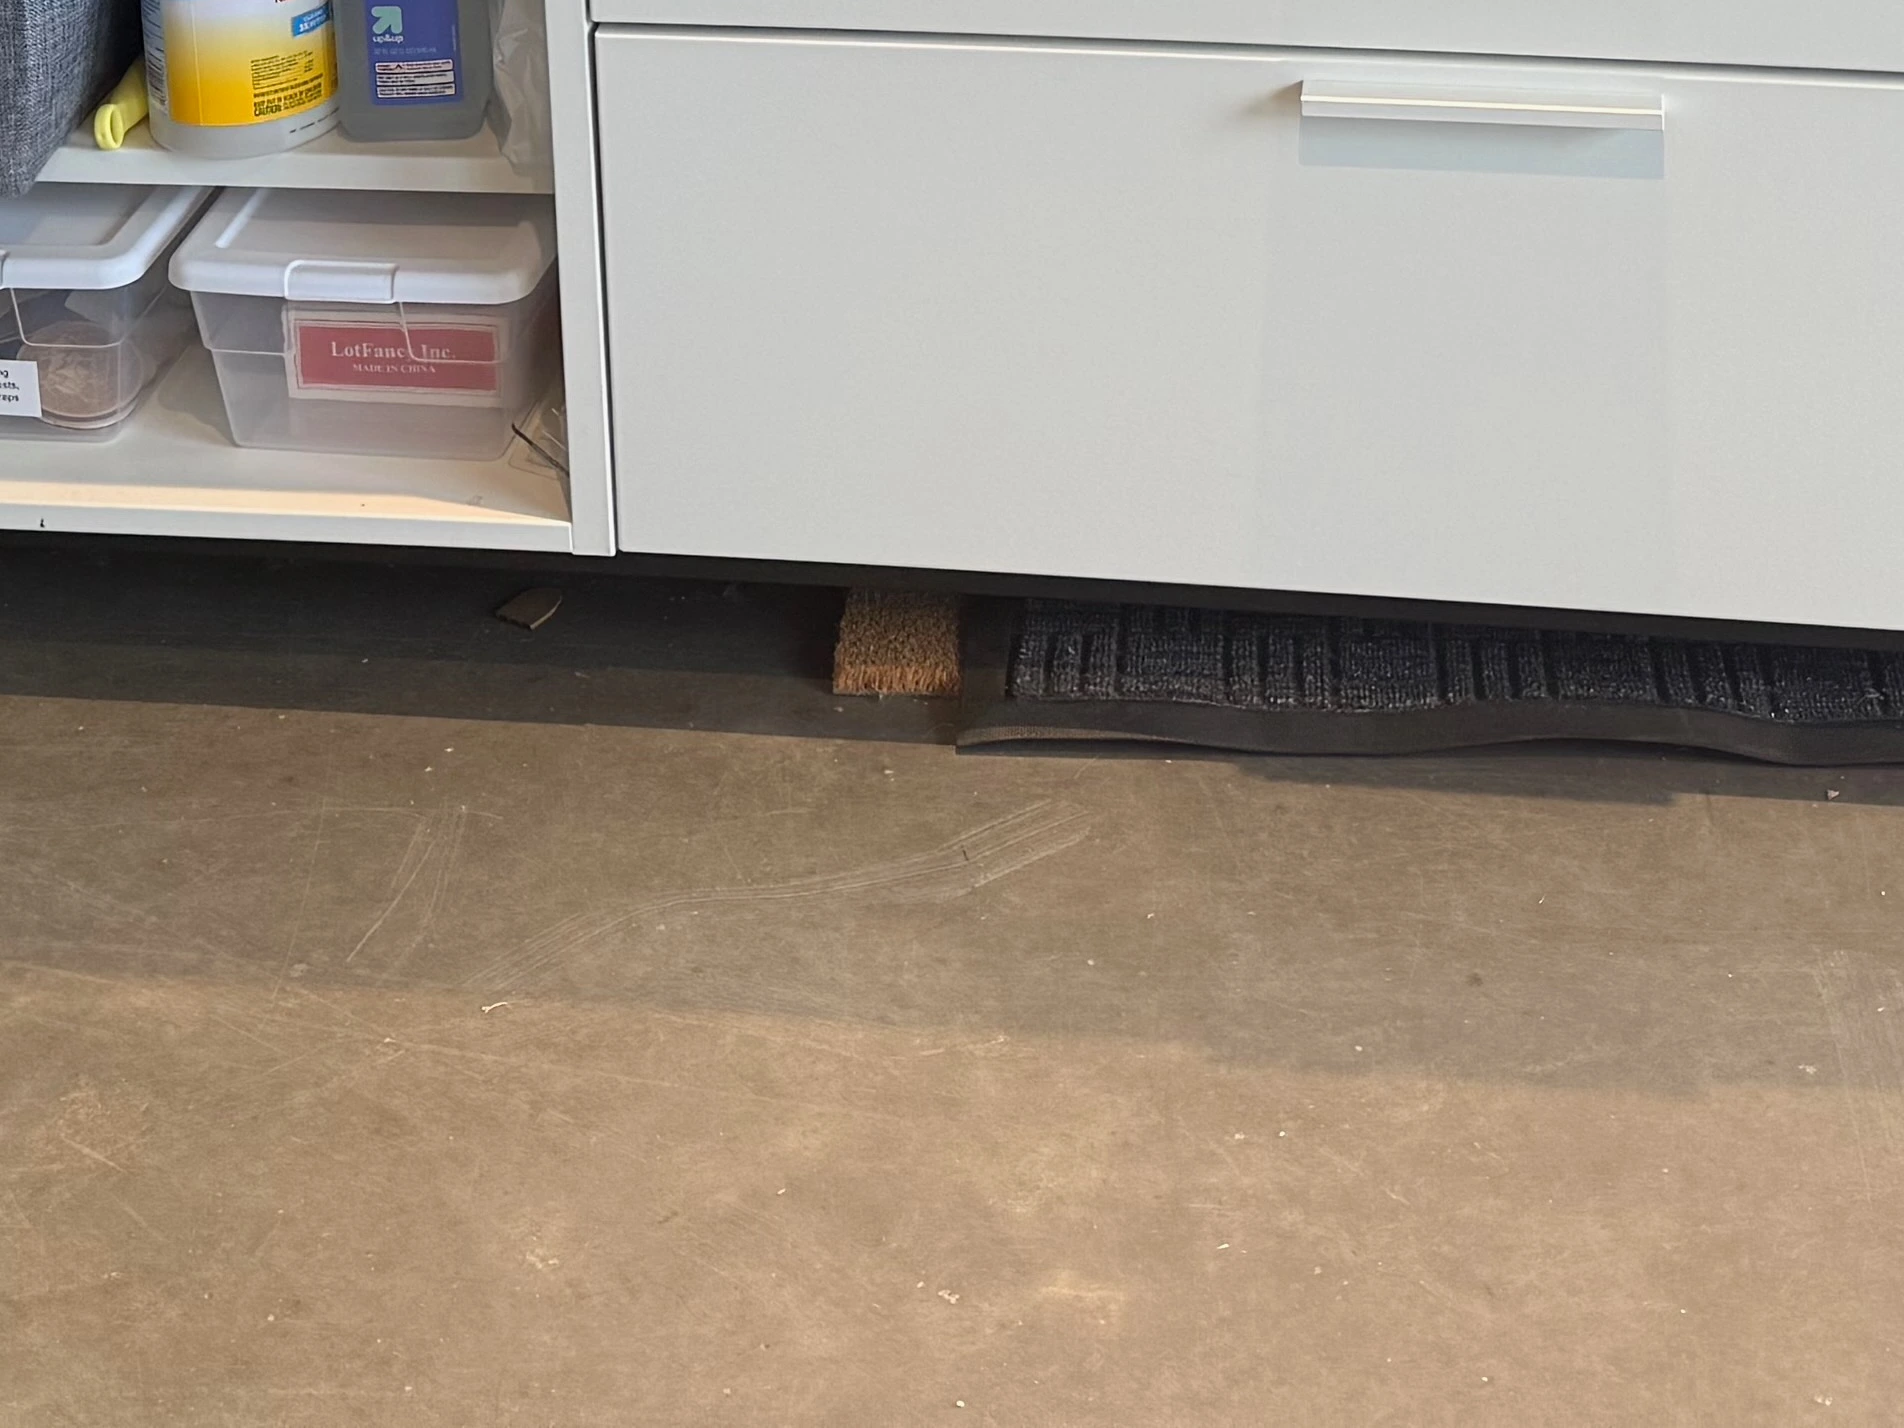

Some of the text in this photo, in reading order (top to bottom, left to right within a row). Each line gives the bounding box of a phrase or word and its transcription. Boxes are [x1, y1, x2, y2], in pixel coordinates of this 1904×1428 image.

[421, 344, 456, 360] Inc.
[353, 363, 436, 373] MADE IN CHINA
